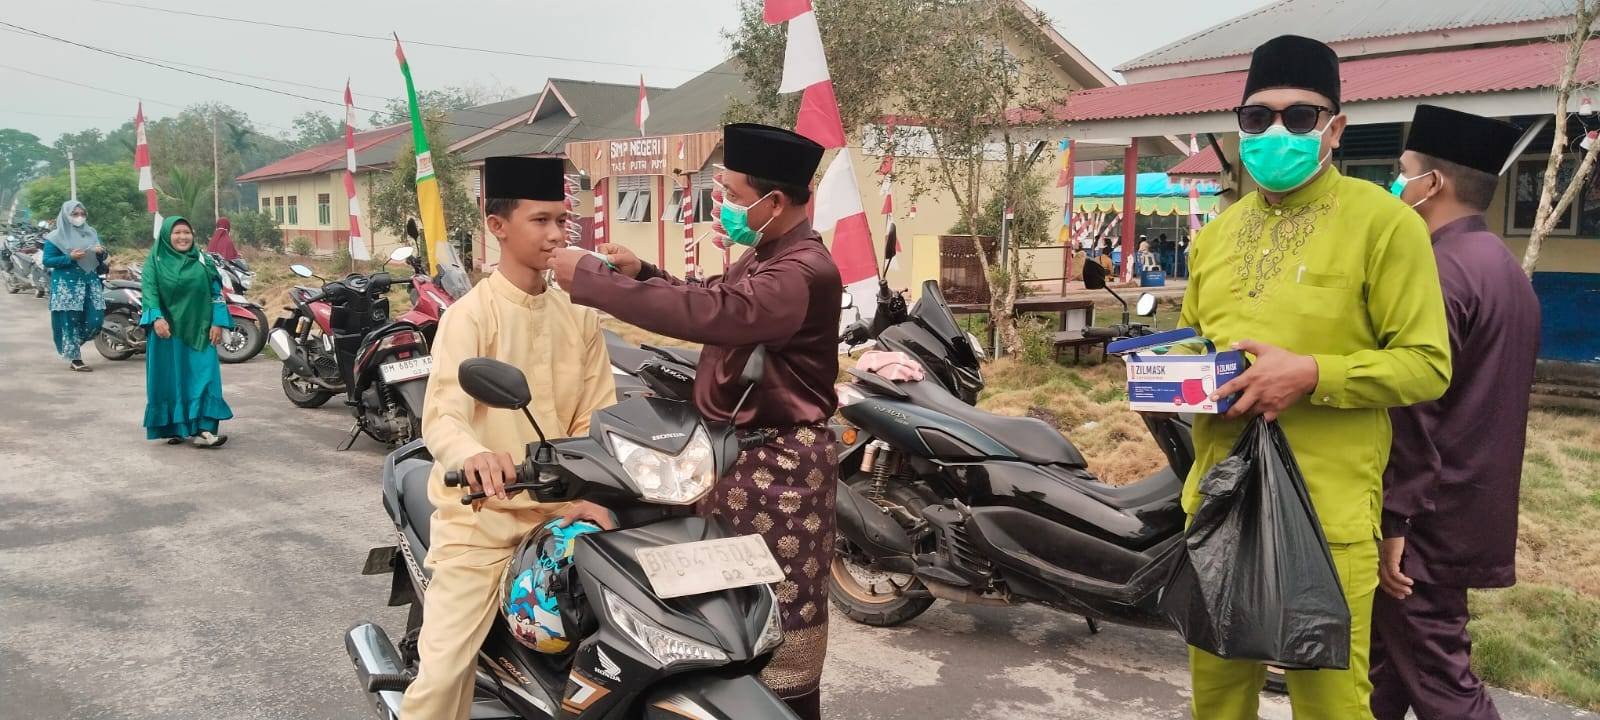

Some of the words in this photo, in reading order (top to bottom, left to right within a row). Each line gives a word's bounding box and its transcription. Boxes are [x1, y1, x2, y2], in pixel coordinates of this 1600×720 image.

[611, 142, 627, 159] SMP
[630, 138, 661, 156] NEGERI
[630, 160, 647, 171] PUTRI
[1136, 365, 1166, 375] ZILMASK
[652, 432, 688, 441] HONDA
[594, 666, 622, 683] HONDA
